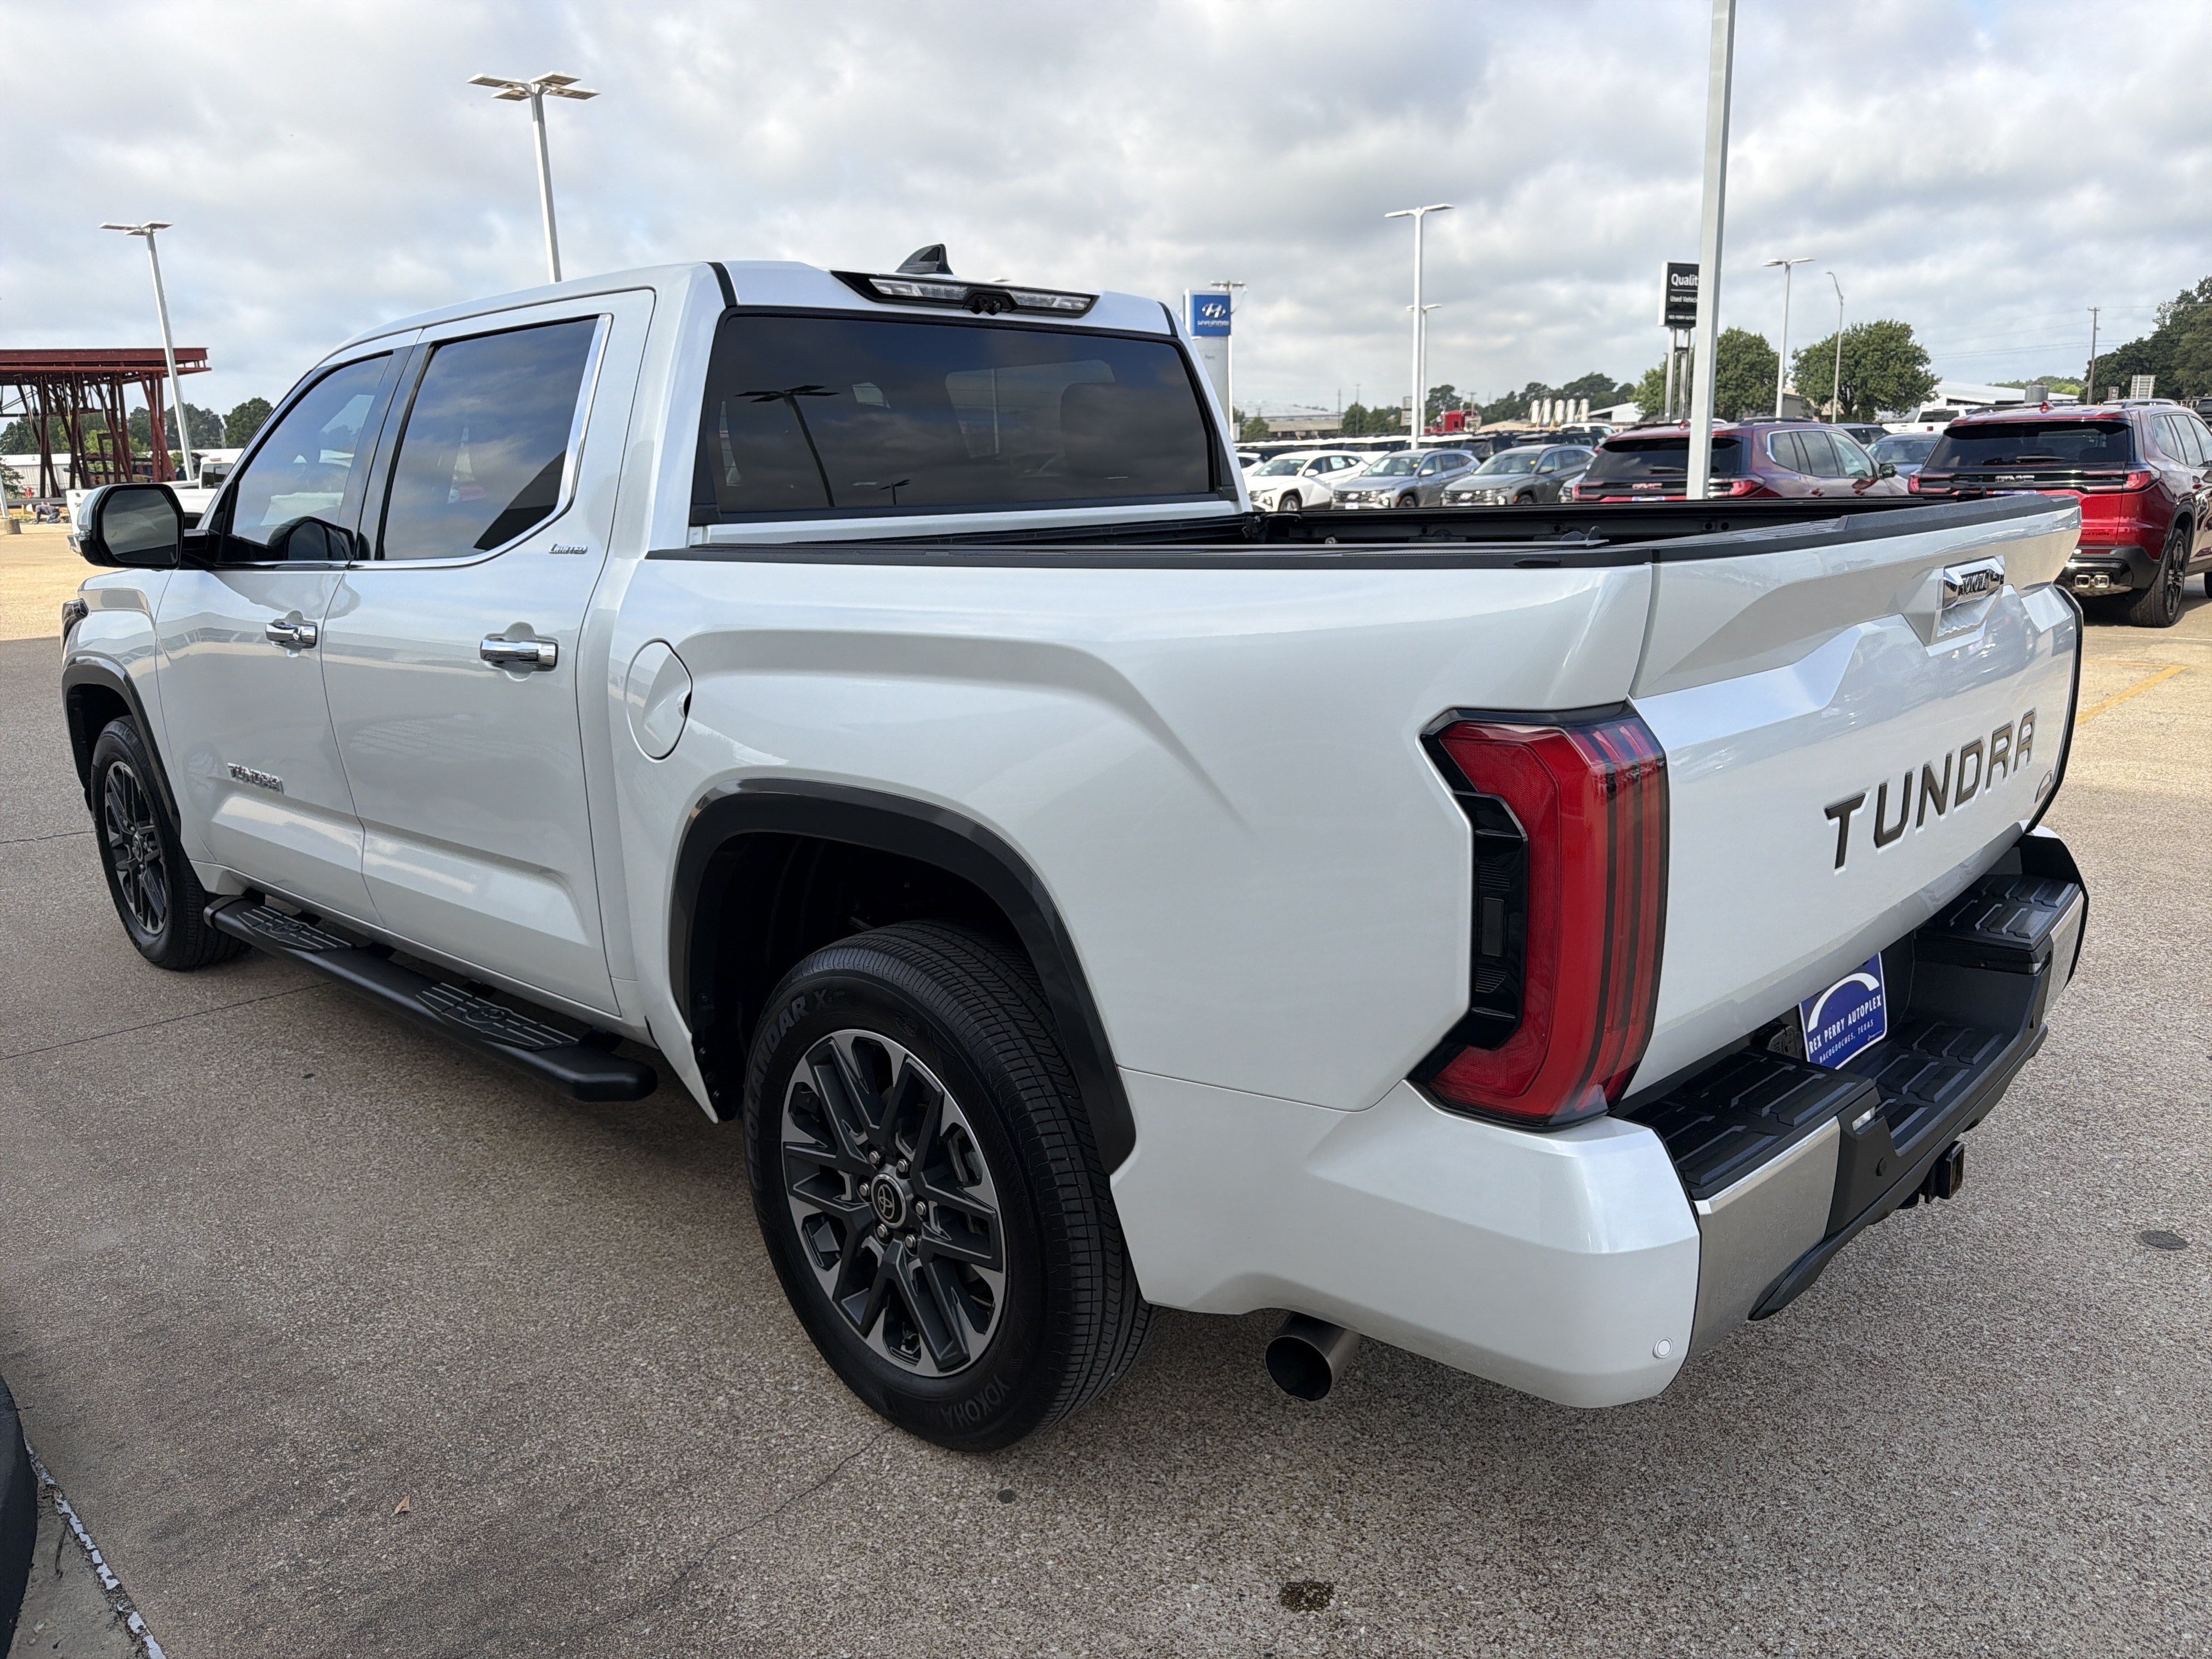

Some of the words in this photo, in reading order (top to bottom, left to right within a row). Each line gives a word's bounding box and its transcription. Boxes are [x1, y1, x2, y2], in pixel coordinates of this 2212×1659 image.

[1671, 273, 1699, 286] Qualit
[227, 763, 284, 794] TUNDRA
[1824, 709, 2036, 870] TUNDRA
[1809, 1036, 1822, 1054] REX
[1824, 1018, 1844, 1043] PERRY
[1848, 994, 1881, 1026] AUTOPLEX
[1819, 1033, 1855, 1064] NACOGDOCHES,
[1858, 1019, 1874, 1035] TEXAS
